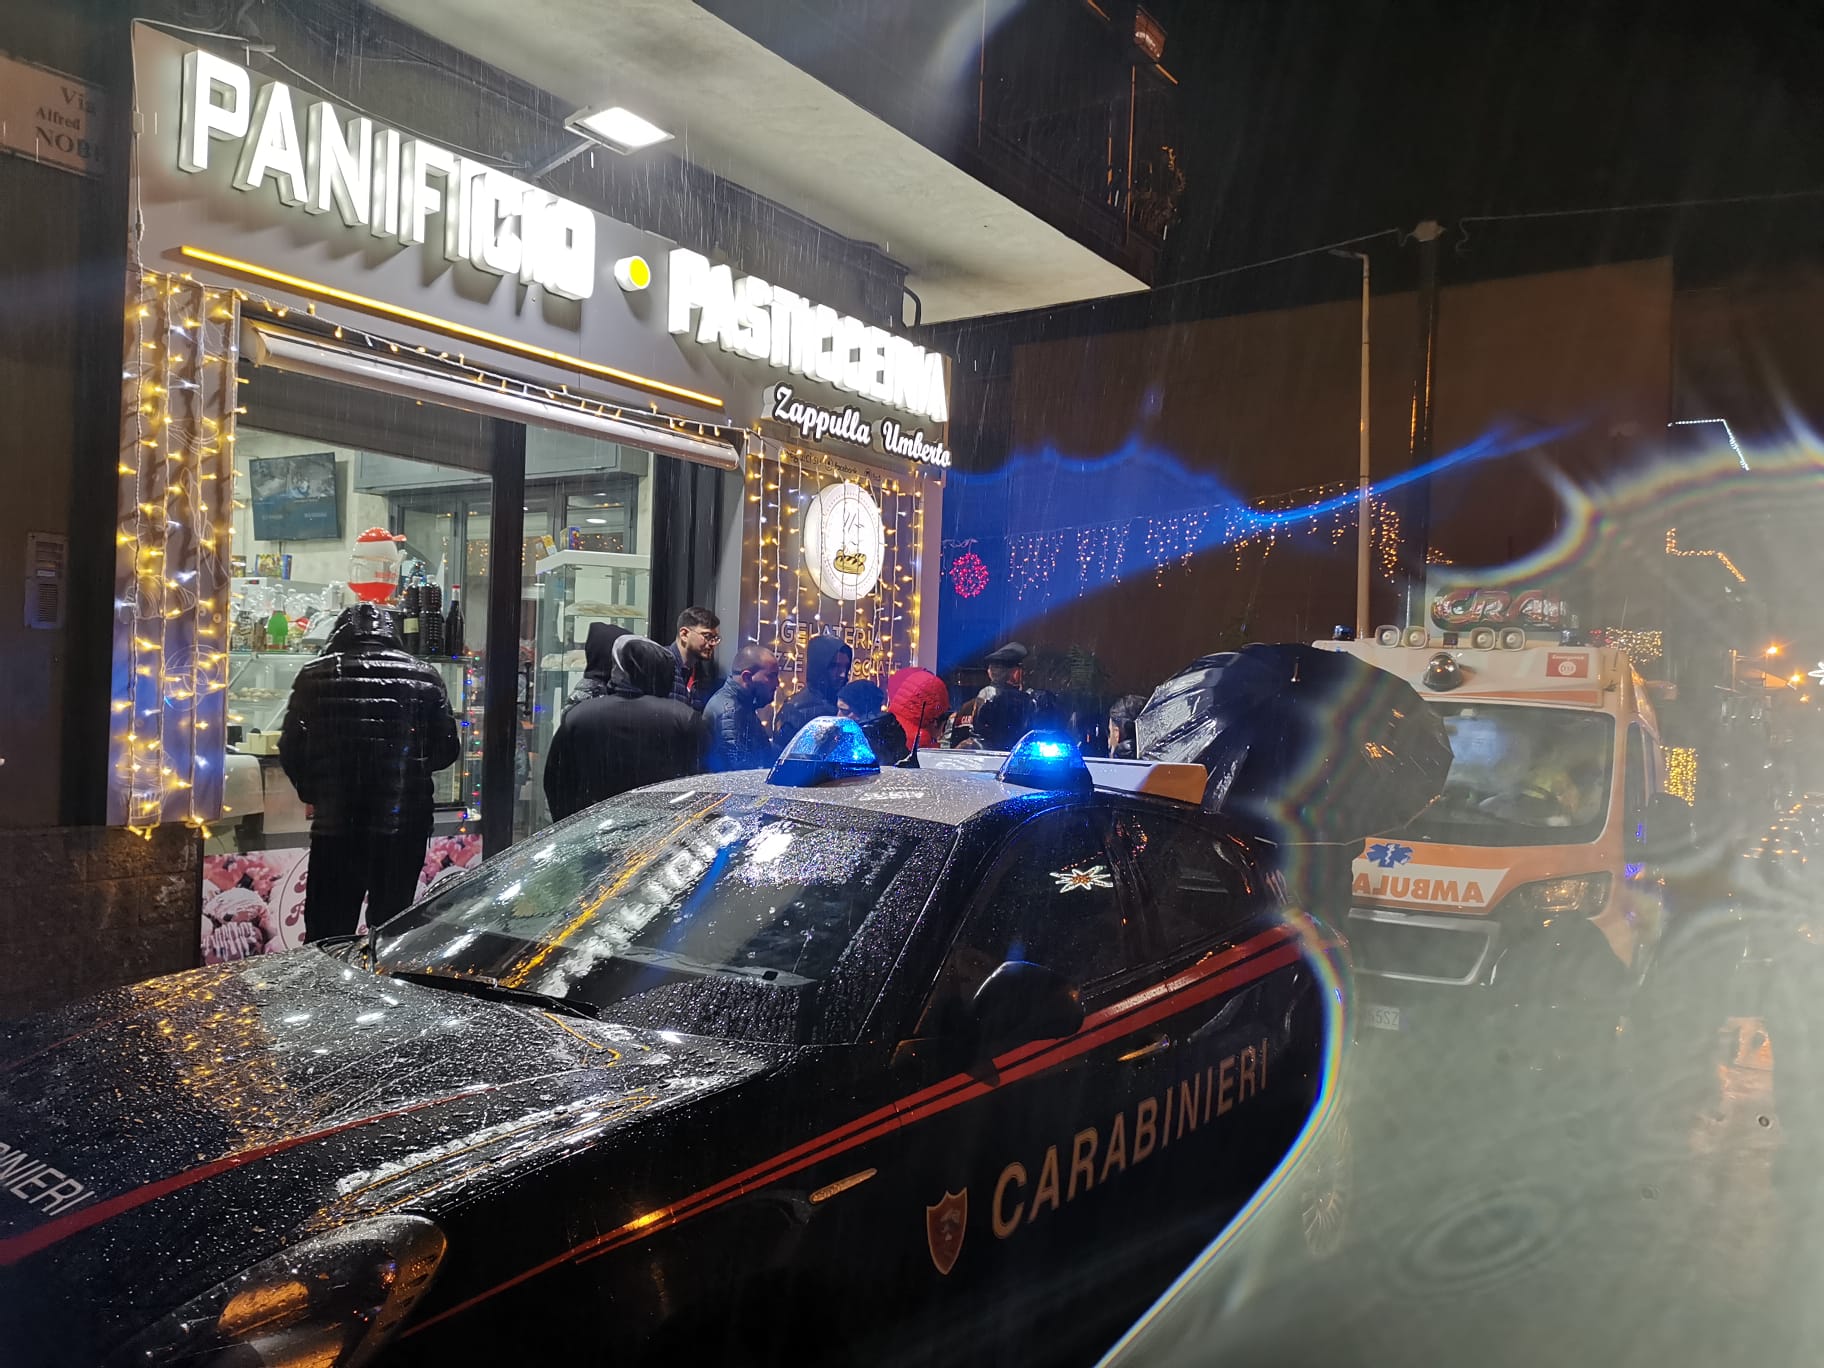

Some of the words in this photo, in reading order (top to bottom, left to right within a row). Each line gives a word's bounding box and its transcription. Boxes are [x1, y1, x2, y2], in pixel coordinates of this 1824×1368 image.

[60, 86, 97, 115] Via
[179, 49, 596, 301] PANIFICIO
[668, 247, 950, 423] PASTICCERIA
[774, 384, 872, 445] Zappulla
[882, 420, 952, 467] Umberto
[991, 1037, 1270, 1240] CARABINIERI
